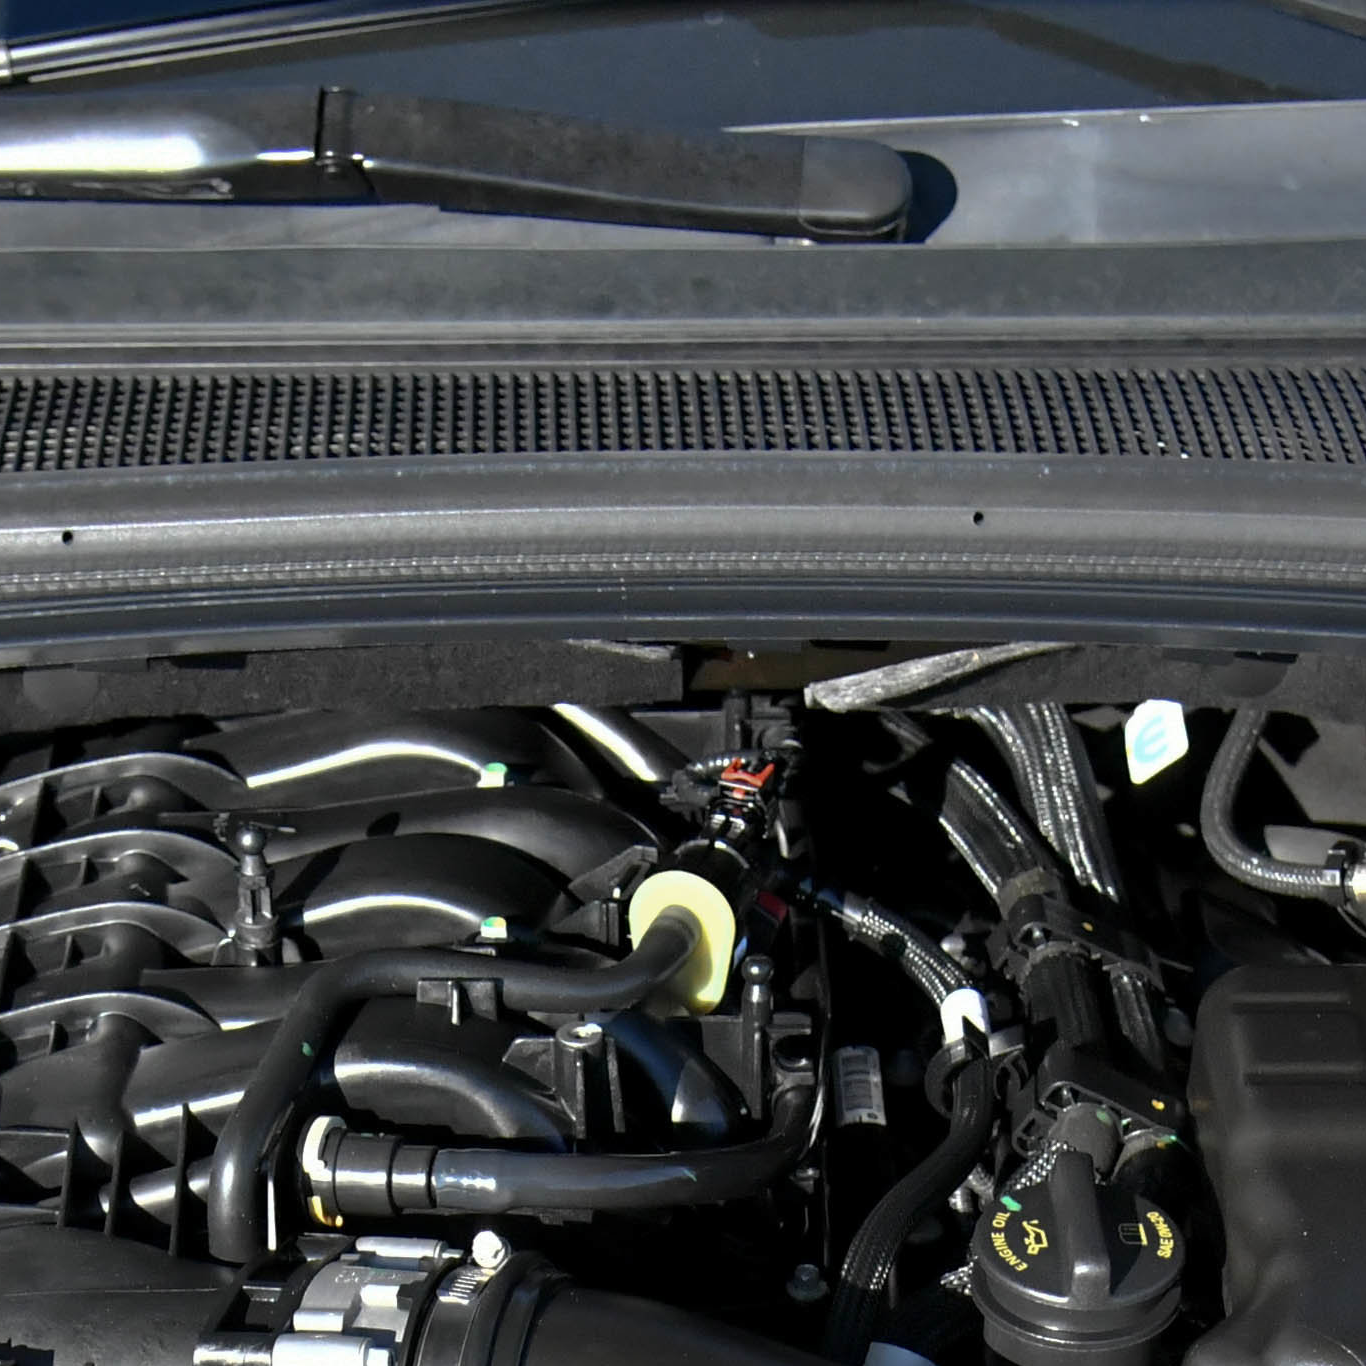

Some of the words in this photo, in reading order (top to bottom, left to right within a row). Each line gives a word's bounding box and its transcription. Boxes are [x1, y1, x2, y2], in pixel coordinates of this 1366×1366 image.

[992, 1212, 1011, 1228] OIL
[991, 1232, 1029, 1272] ENGINE
[1157, 1238, 1174, 1259] SAE
